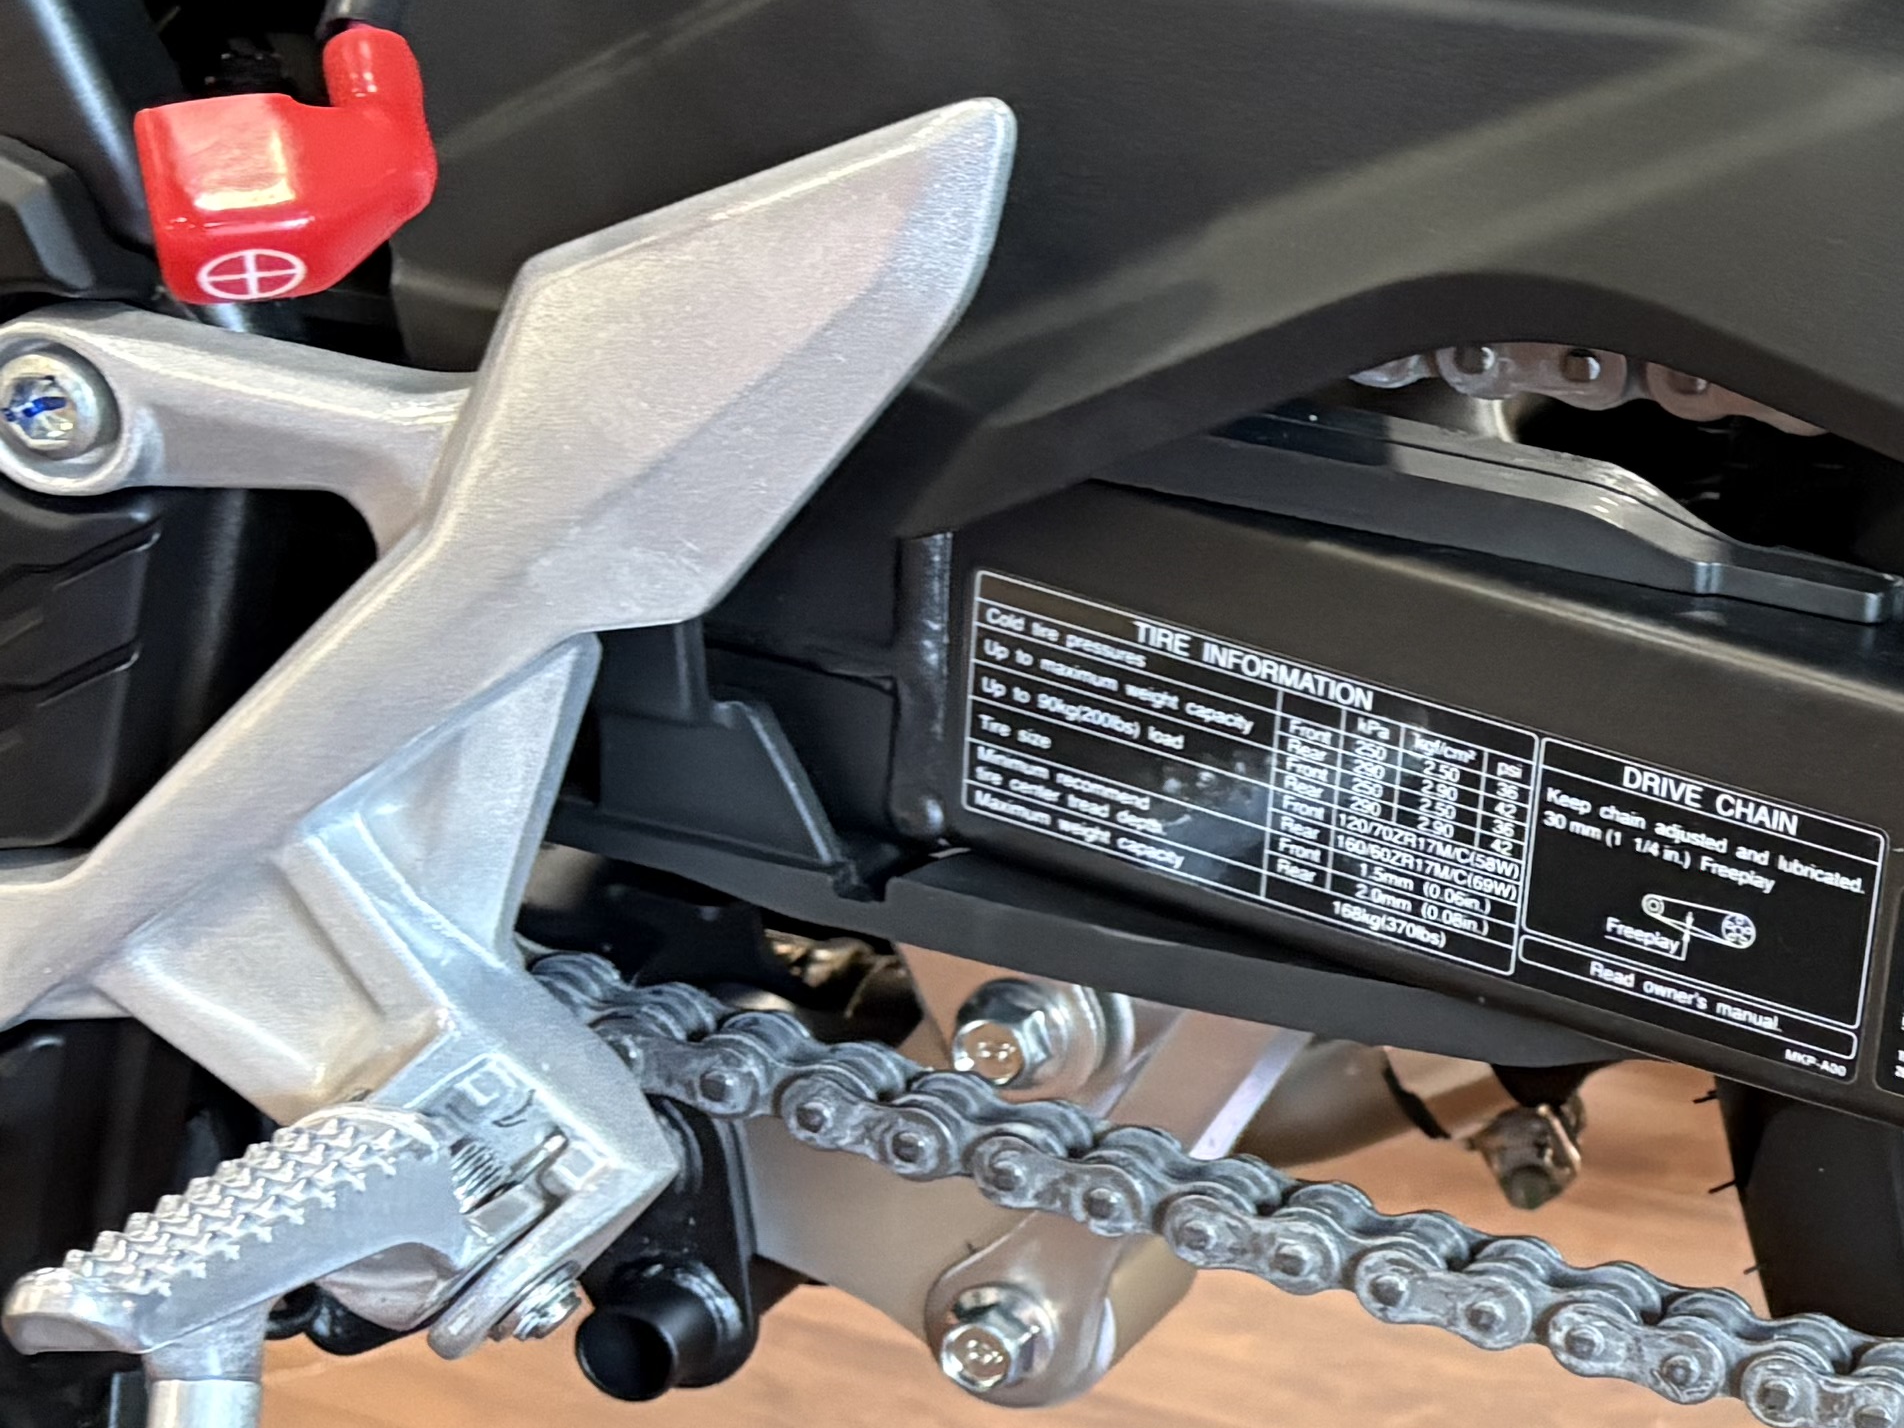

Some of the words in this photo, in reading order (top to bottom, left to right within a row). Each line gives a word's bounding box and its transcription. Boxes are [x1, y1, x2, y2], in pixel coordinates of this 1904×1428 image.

[985, 607, 1025, 631] Cold
[1031, 621, 1059, 641] tire
[1064, 633, 1147, 672] pressures
[1132, 620, 1191, 656] TIRE
[1201, 641, 1373, 711] INFORMATION
[981, 676, 1006, 697] Up
[1012, 686, 1030, 703] to
[1037, 693, 1140, 739] 90kg(200lbs)
[1147, 725, 1184, 749] load
[983, 638, 1009, 660] Up
[1014, 648, 1033, 665] to
[1039, 658, 1118, 691] maximum
[1124, 683, 1179, 709] weight
[1184, 701, 1254, 735] capacity
[978, 713, 1011, 736] Tire
[1017, 728, 1051, 748] size
[1287, 717, 1334, 746] Front
[1353, 737, 1387, 763] 250
[1421, 757, 1460, 783] 2.50
[1494, 780, 1519, 802] 36
[1356, 716, 1391, 740] kPa
[1496, 761, 1522, 778] psi
[975, 765, 1003, 785] tire
[1008, 778, 1061, 802] center
[1066, 793, 1110, 818] tread
[976, 745, 1049, 779] Minimum
[1055, 772, 1151, 810] recommend
[1284, 755, 1330, 784] Front
[1349, 774, 1384, 799] 250
[1417, 794, 1456, 820] 2.50
[1491, 817, 1515, 839] 36
[1286, 736, 1332, 765] Rear
[1351, 756, 1386, 780] 290
[1420, 776, 1458, 801] 2.90
[1493, 801, 1517, 819] 42
[1621, 765, 1703, 808] DRIVE
[1715, 789, 1801, 836] CHAIN
[974, 789, 1051, 825] Maximum
[1057, 818, 1111, 844] weight
[1116, 836, 1185, 869] capacity
[1280, 793, 1325, 821] Front
[1337, 812, 1519, 879] 120/70ZR17M/C(58W)
[1282, 773, 1328, 802] Rear
[1348, 793, 1382, 817] 290
[1416, 813, 1454, 839] 2.90
[1489, 835, 1513, 857] 42
[1542, 810, 1567, 829] 30
[1568, 820, 1602, 840] mm
[1605, 828, 1621, 847] (1
[1633, 837, 1659, 856] 1/4
[1662, 844, 1691, 869] in.)
[1699, 855, 1775, 893] Freeplay
[1546, 786, 1591, 815] Keep
[1598, 805, 1646, 829] chain
[1653, 822, 1728, 853] adjusted
[1734, 845, 1769, 865] and
[1777, 854, 1864, 894] lubricated.
[1276, 857, 1316, 882] Rear
[1354, 882, 1412, 912] 2.0mm
[1277, 836, 1321, 863] Front
[1358, 862, 1414, 891] 1.5mm
[1278, 814, 1320, 839] Rear
[1335, 834, 1517, 900] 160/60ZR17M/C(69W)
[1332, 900, 1446, 948] 168kg(370lbs)
[1605, 916, 1680, 954] Freeplay
[1589, 960, 1635, 987] Read
[1642, 980, 1707, 1009] owner's
[1715, 1002, 1782, 1032] manual.
